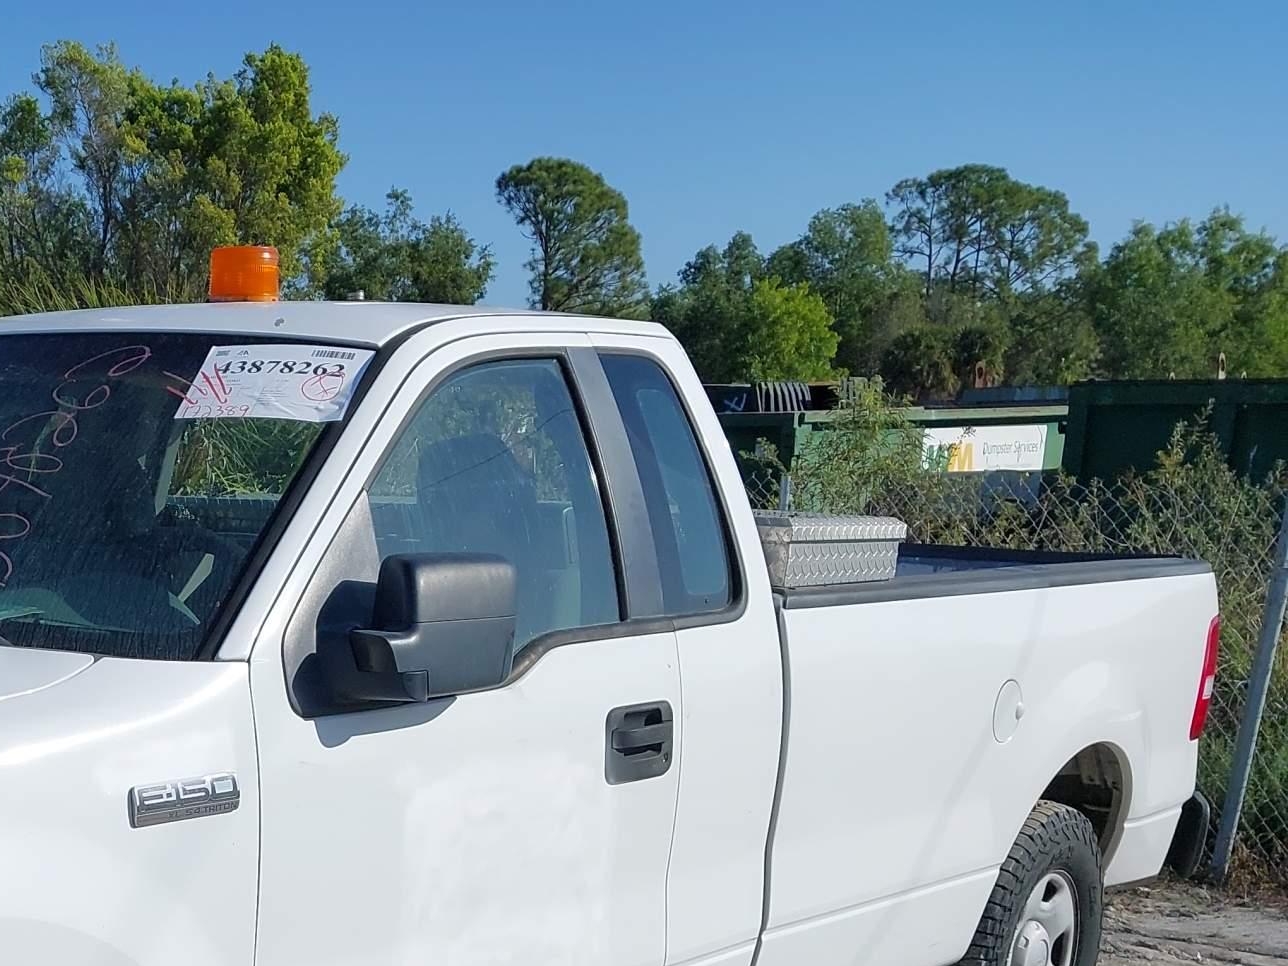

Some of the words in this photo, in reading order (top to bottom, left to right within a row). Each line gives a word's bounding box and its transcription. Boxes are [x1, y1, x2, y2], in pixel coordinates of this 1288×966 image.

[215, 359, 347, 378] 43878262
[983, 442, 1013, 455] Dumpster
[1014, 440, 1039, 453] Services
[201, 801, 238, 815] TRITON
